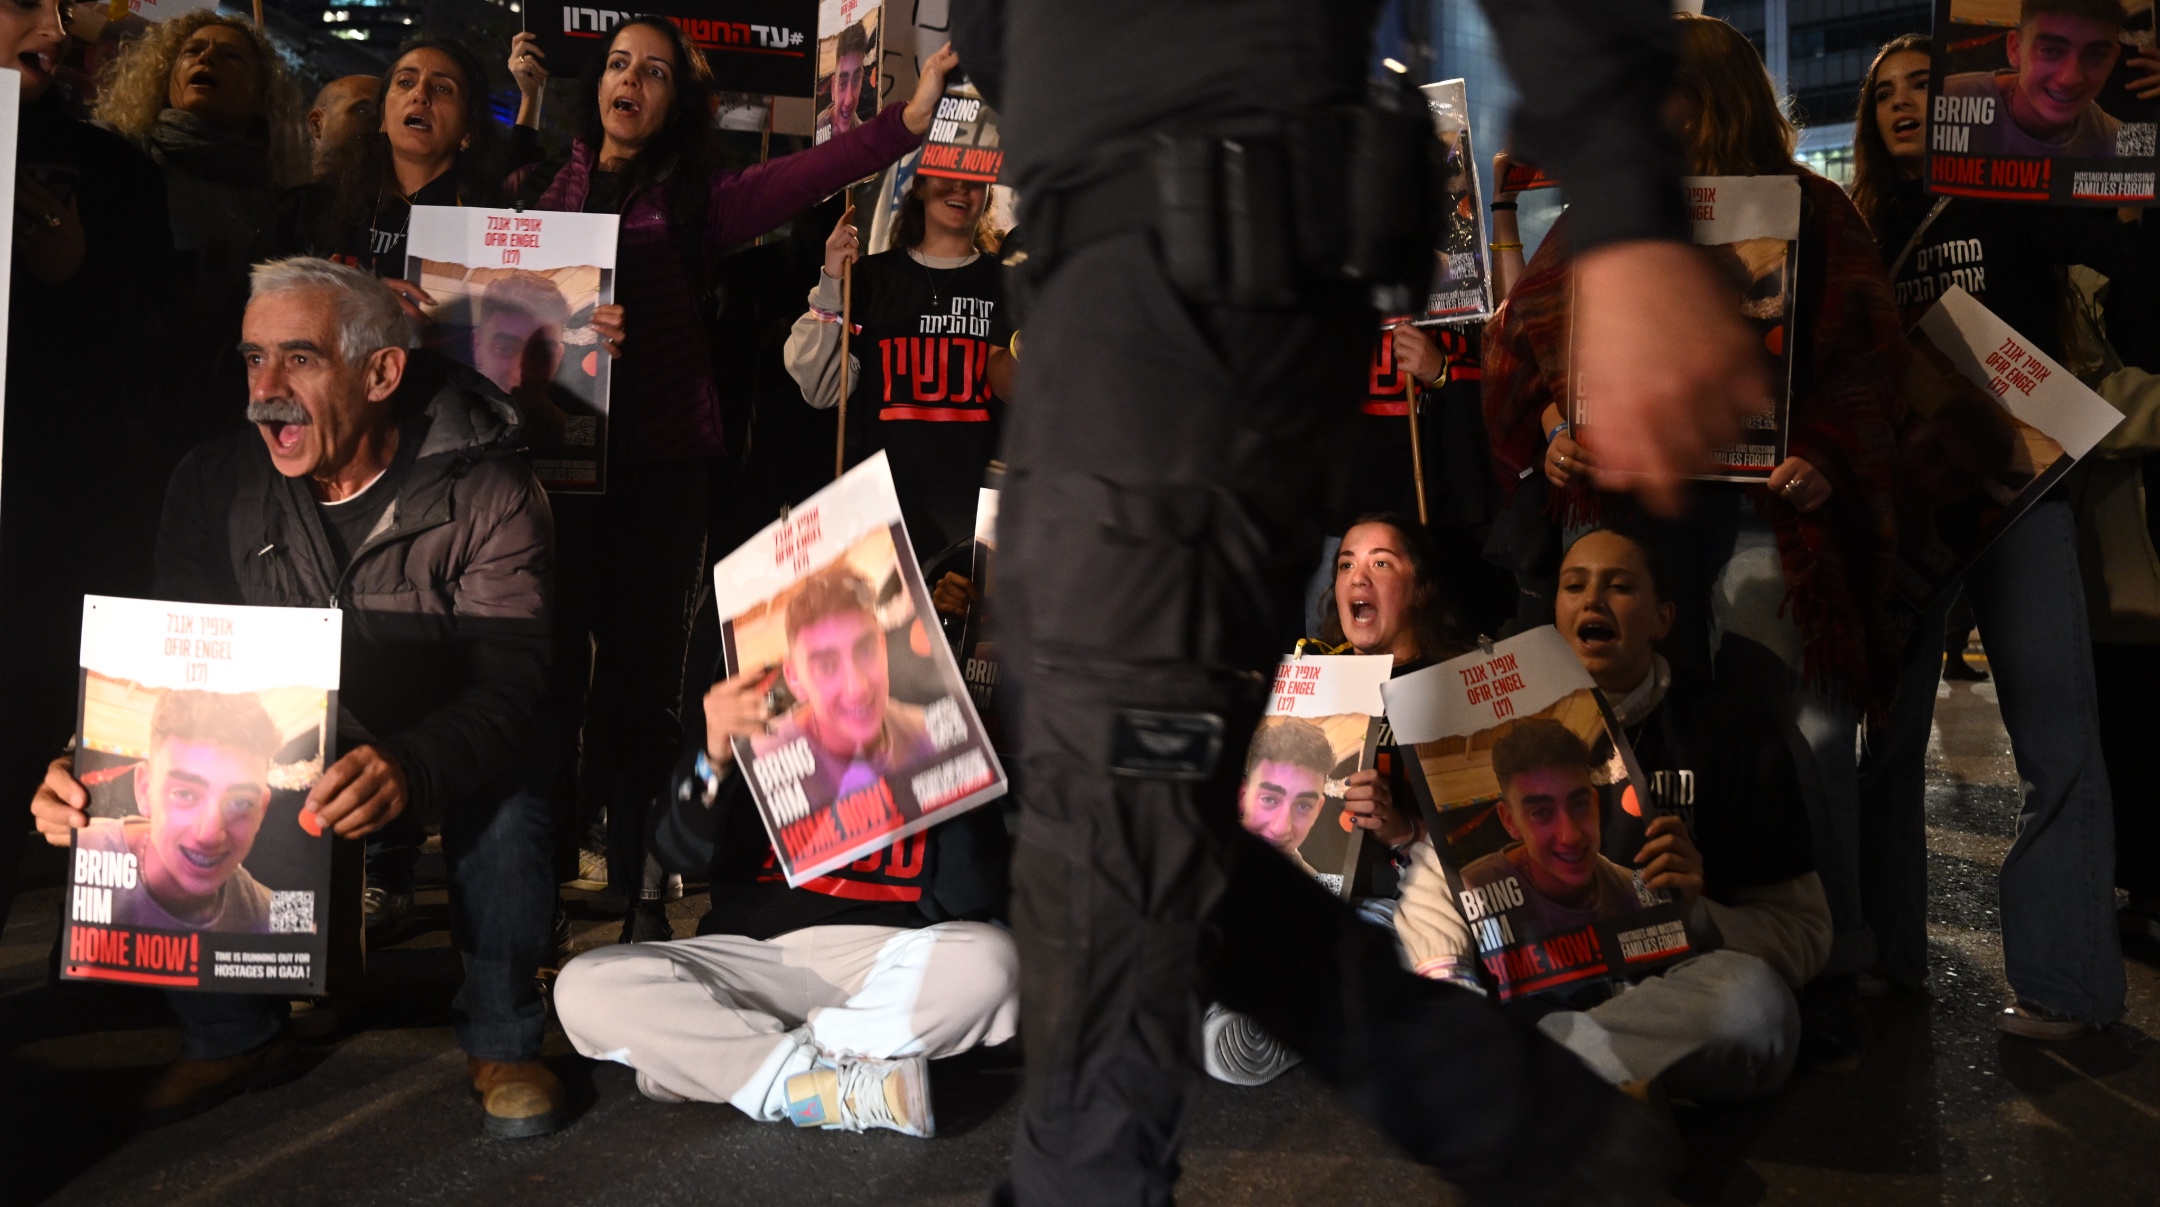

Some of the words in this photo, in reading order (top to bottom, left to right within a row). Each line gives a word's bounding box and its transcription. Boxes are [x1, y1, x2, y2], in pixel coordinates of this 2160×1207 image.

[936, 97, 981, 122] BRING
[1934, 95, 1996, 125] BRING
[928, 118, 959, 144] HIM
[1932, 125, 1970, 153] HIM
[920, 144, 962, 169] HOME
[961, 148, 1005, 174] NOW!
[1931, 155, 1986, 185] HOME
[1991, 158, 2052, 189] NOW!
[2074, 171, 2109, 182] HOSTAGES
[2108, 172, 2123, 182] AND
[2124, 172, 2155, 183] MISSING
[2073, 181, 2116, 196] FAMILIES
[2118, 182, 2155, 196] FORUM
[1688, 205, 1715, 221] NGEL
[485, 232, 508, 247] OFIR
[510, 233, 541, 248] ENGEL
[502, 248, 521, 266] (17)
[1917, 237, 1984, 272] מחזירים
[1896, 275, 1936, 306] הבית
[919, 315, 967, 334] הביתה
[1999, 337, 2026, 363] אנגל
[1985, 351, 2011, 375] OFIR
[2005, 367, 2037, 397] ENGEL
[2021, 354, 2052, 384] אופיר
[1986, 375, 2010, 398] (17)
[1744, 453, 1775, 468] FORUM
[164, 637, 191, 657] OFIR
[195, 639, 233, 660] ENGEL
[186, 661, 208, 684] (17)
[1295, 665, 1321, 680] אופיר
[1459, 664, 1488, 687] אנגל
[1486, 653, 1519, 677] אופיר
[1270, 679, 1287, 694] FIR
[1287, 681, 1316, 696] ENGEL
[1466, 683, 1493, 705] OFIR
[1492, 672, 1526, 697] ENGEL
[1277, 695, 1296, 712] (17)
[1492, 696, 1515, 720] (17)
[74, 848, 138, 889] BRING
[72, 886, 113, 924] HIM
[1459, 876, 1525, 922] BRING
[1470, 913, 1516, 954] HIM
[1621, 937, 1659, 960] FAMILIES
[1656, 930, 1689, 952] FORUM
[70, 926, 129, 966] HOME
[135, 932, 199, 973] NOW!
[214, 950, 232, 962] TIME
[232, 951, 241, 962] IS
[242, 951, 277, 963] RUNNING
[277, 952, 293, 964] OUT
[294, 953, 310, 964] FOR
[1483, 943, 1546, 987] HOME
[1543, 925, 1604, 972] NOW!
[214, 963, 265, 978] HOSTAGES
[265, 965, 277, 978] IN
